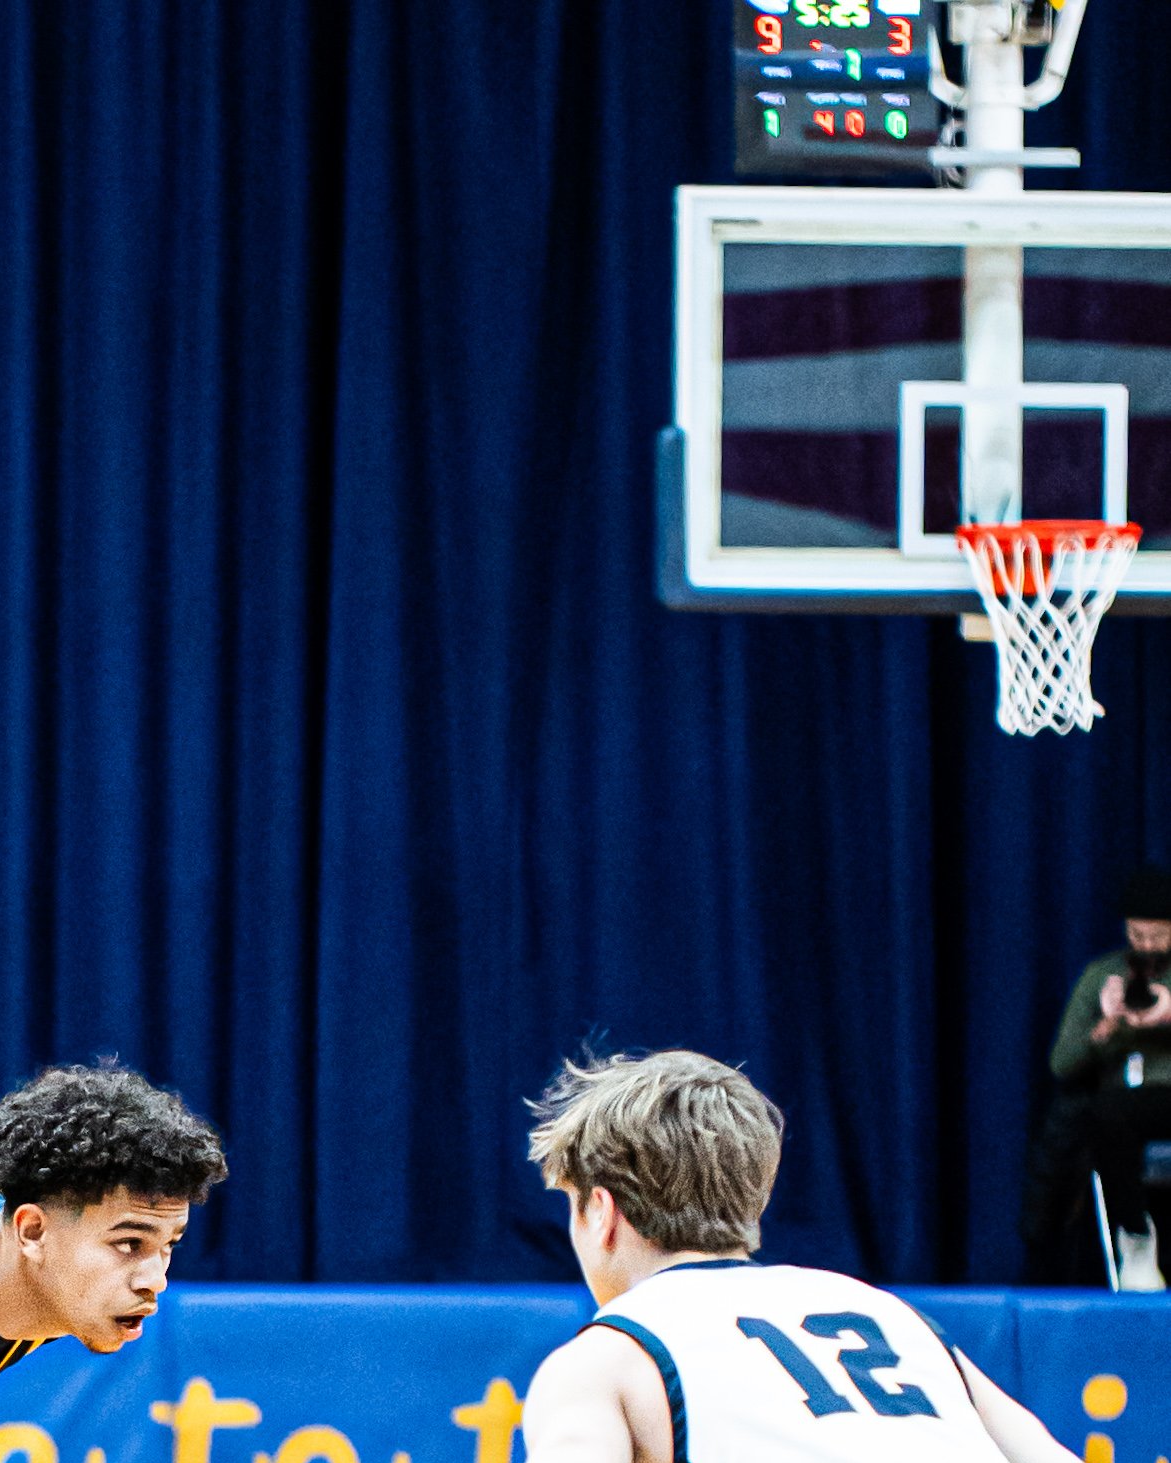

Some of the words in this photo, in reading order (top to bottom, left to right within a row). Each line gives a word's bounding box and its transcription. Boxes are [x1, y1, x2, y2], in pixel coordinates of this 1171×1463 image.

[754, 14, 783, 55] 9
[887, 16, 913, 56] 3
[736, 1311, 942, 1419] 12
